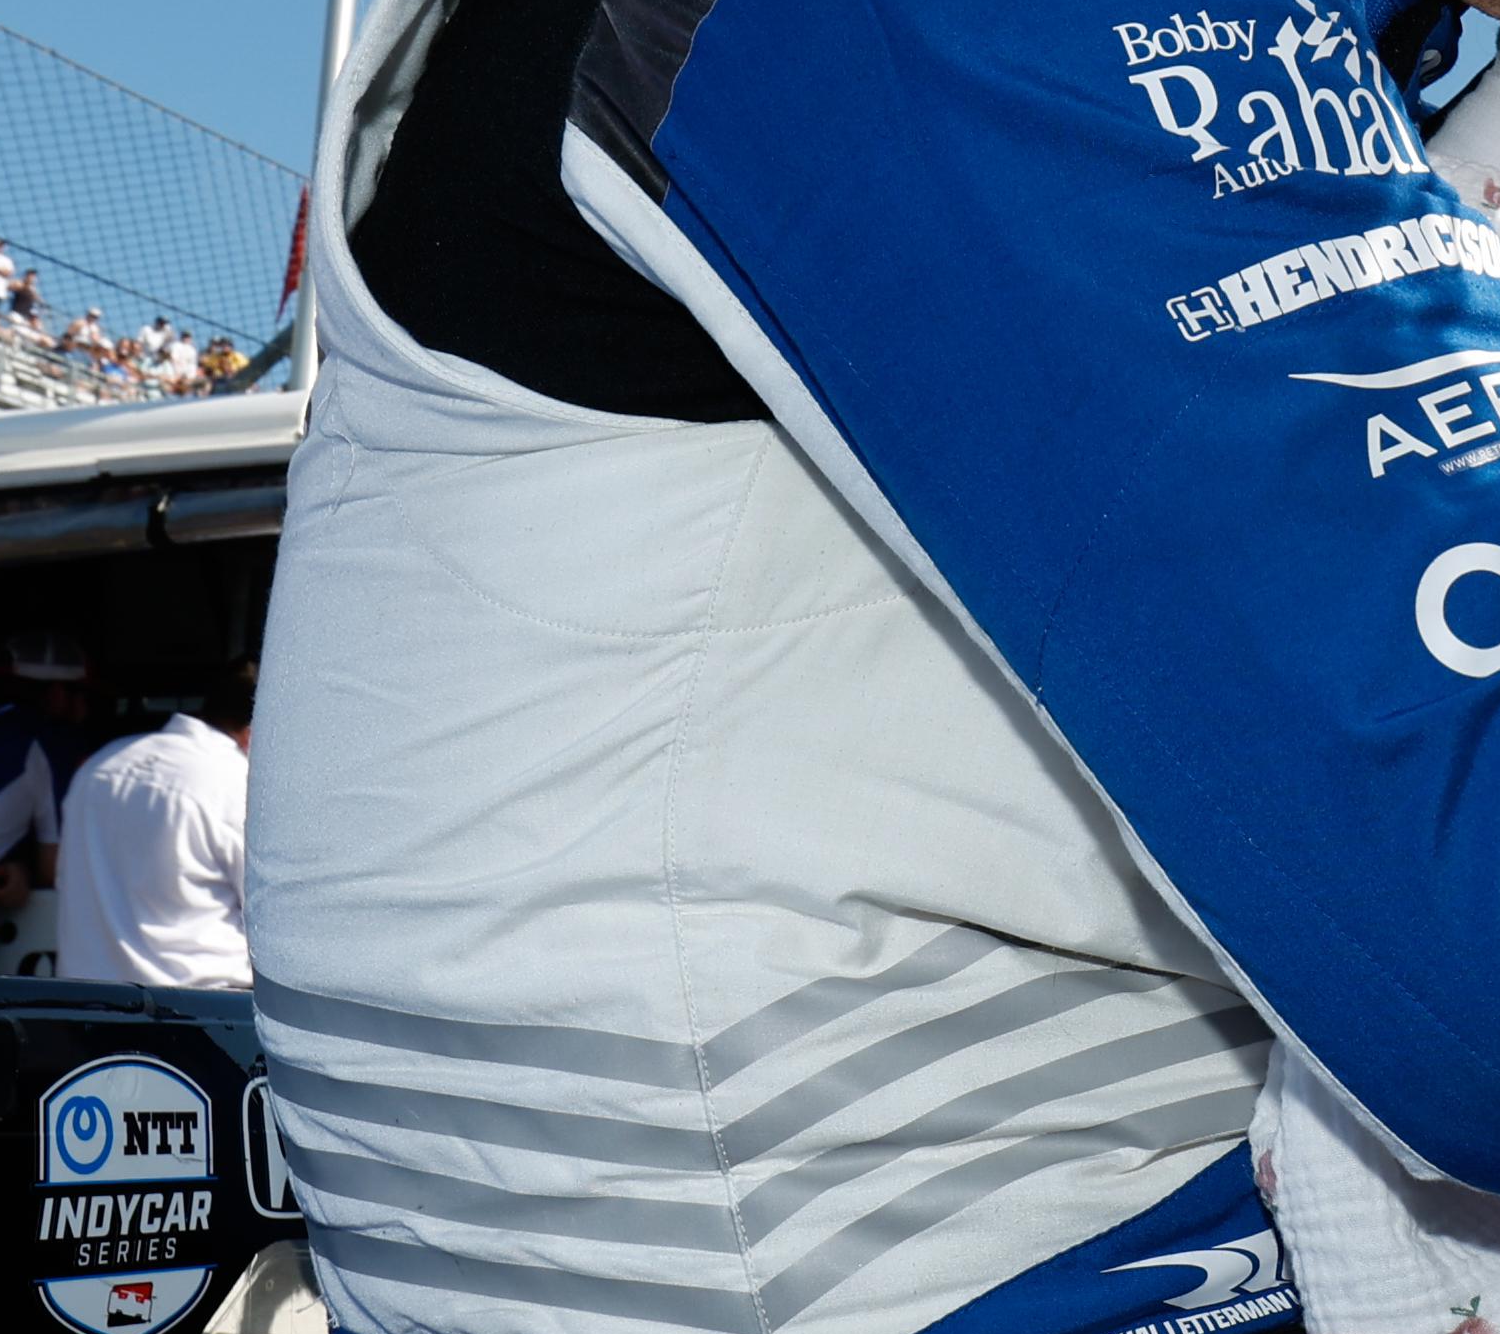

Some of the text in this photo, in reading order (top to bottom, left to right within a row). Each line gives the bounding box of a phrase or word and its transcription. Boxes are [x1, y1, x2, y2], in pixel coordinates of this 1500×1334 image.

[1112, 10, 1256, 66] Bobby
[1128, 43, 1431, 177] Rahal
[123, 1112, 198, 1155] NTT
[39, 1190, 212, 1241] INDYCAR
[77, 1237, 177, 1266] SERIES
